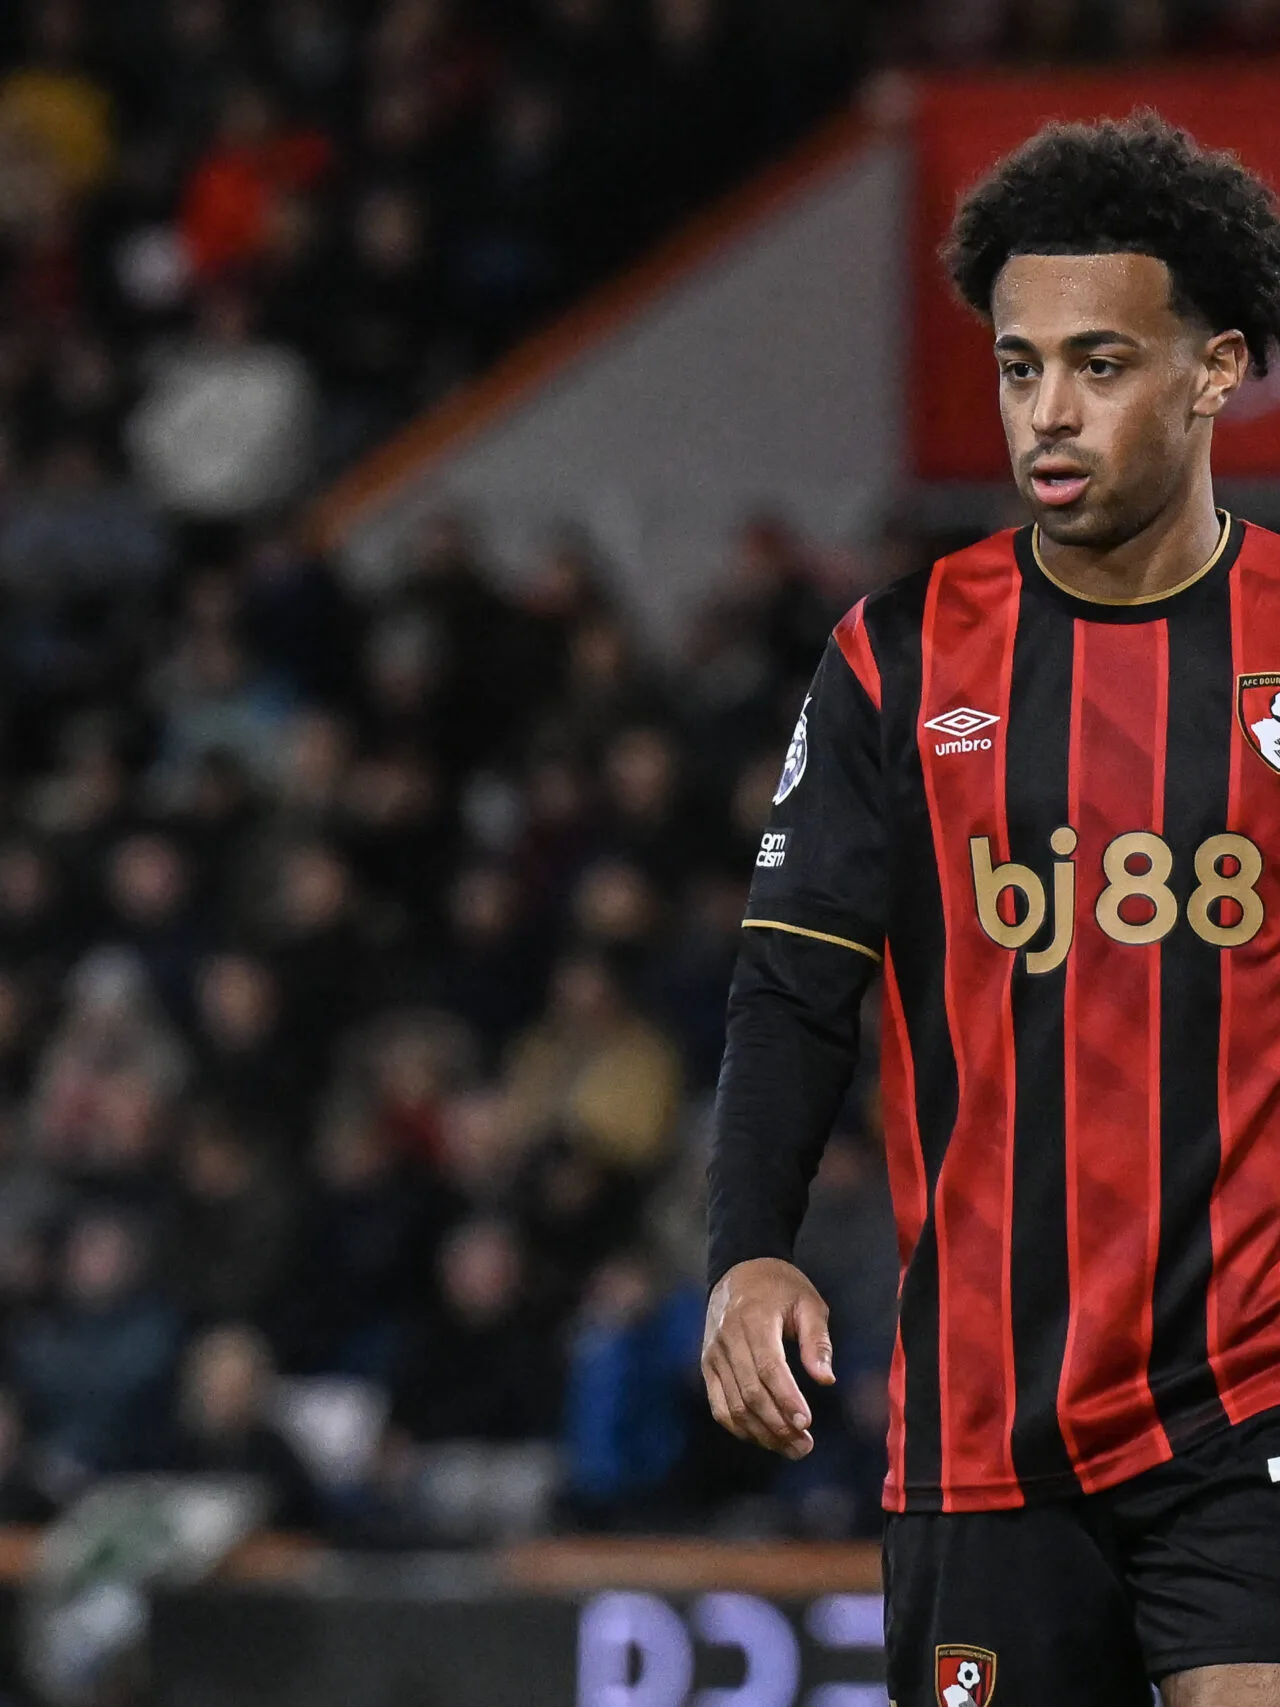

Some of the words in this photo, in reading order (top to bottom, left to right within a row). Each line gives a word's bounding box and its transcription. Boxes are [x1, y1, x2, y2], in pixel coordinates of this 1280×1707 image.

[1242, 678, 1258, 687] AFC
[935, 738, 992, 756] umbro
[970, 826, 1264, 974] bj88
